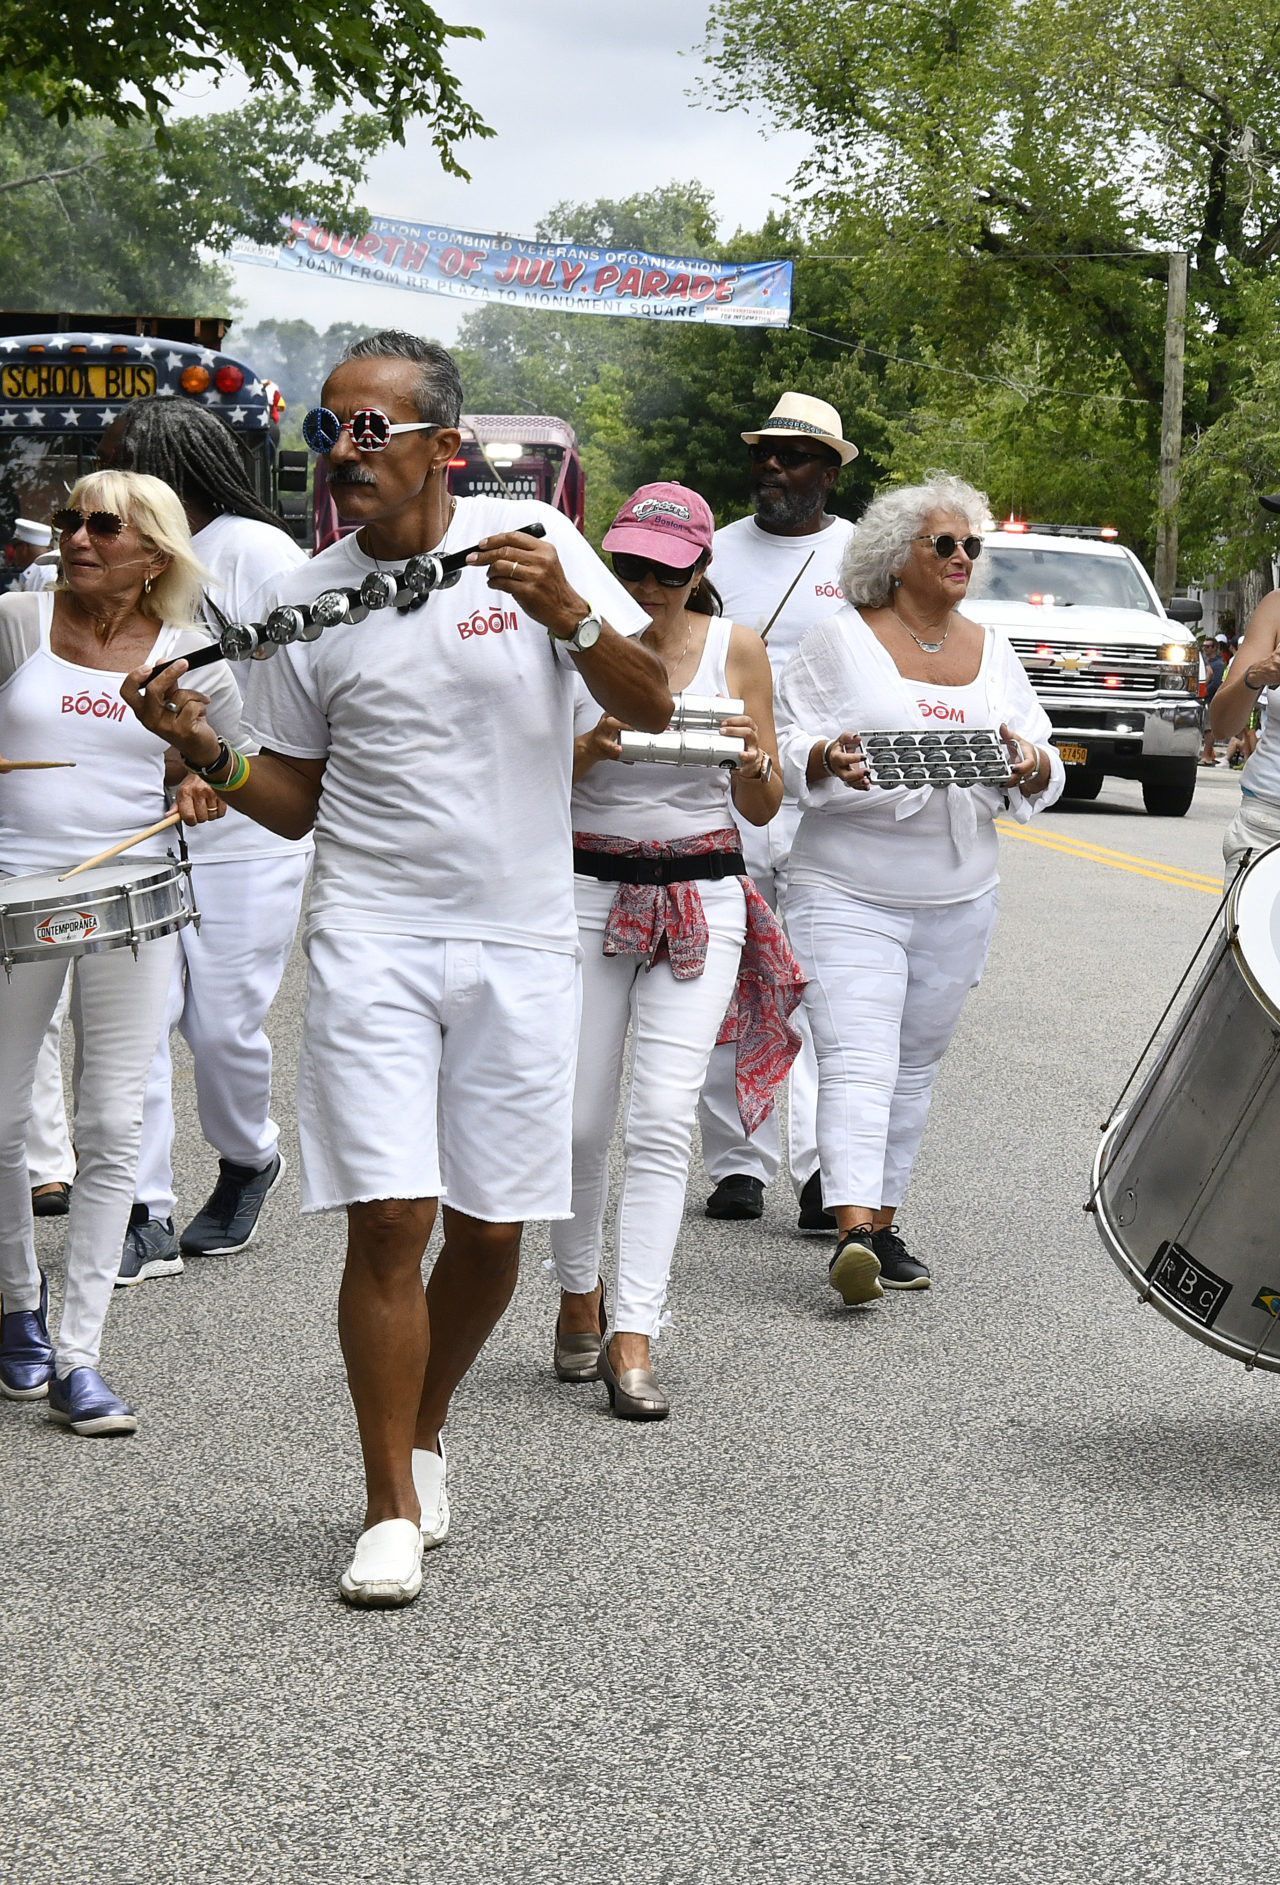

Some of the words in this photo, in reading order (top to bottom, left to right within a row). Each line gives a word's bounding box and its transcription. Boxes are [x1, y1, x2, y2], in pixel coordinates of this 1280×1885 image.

[287, 221, 430, 272] FOURTH
[438, 247, 488, 281] OF
[494, 254, 587, 293] JULY
[593, 265, 739, 303] PARADE
[427, 229, 513, 251] COMBINED
[518, 243, 600, 261] VETERANS
[605, 252, 722, 274] ORGANIZATION
[296, 256, 343, 276] 10AM
[350, 264, 399, 284] FROM
[406, 275, 429, 289] RR
[437, 279, 491, 297] PLAZA
[497, 288, 518, 301] TO
[524, 292, 621, 311] MONUMENT
[629, 303, 698, 317] SQUARE
[7, 365, 95, 397] SCHOOL
[105, 366, 151, 397] BUS
[654, 515, 683, 531] Boston
